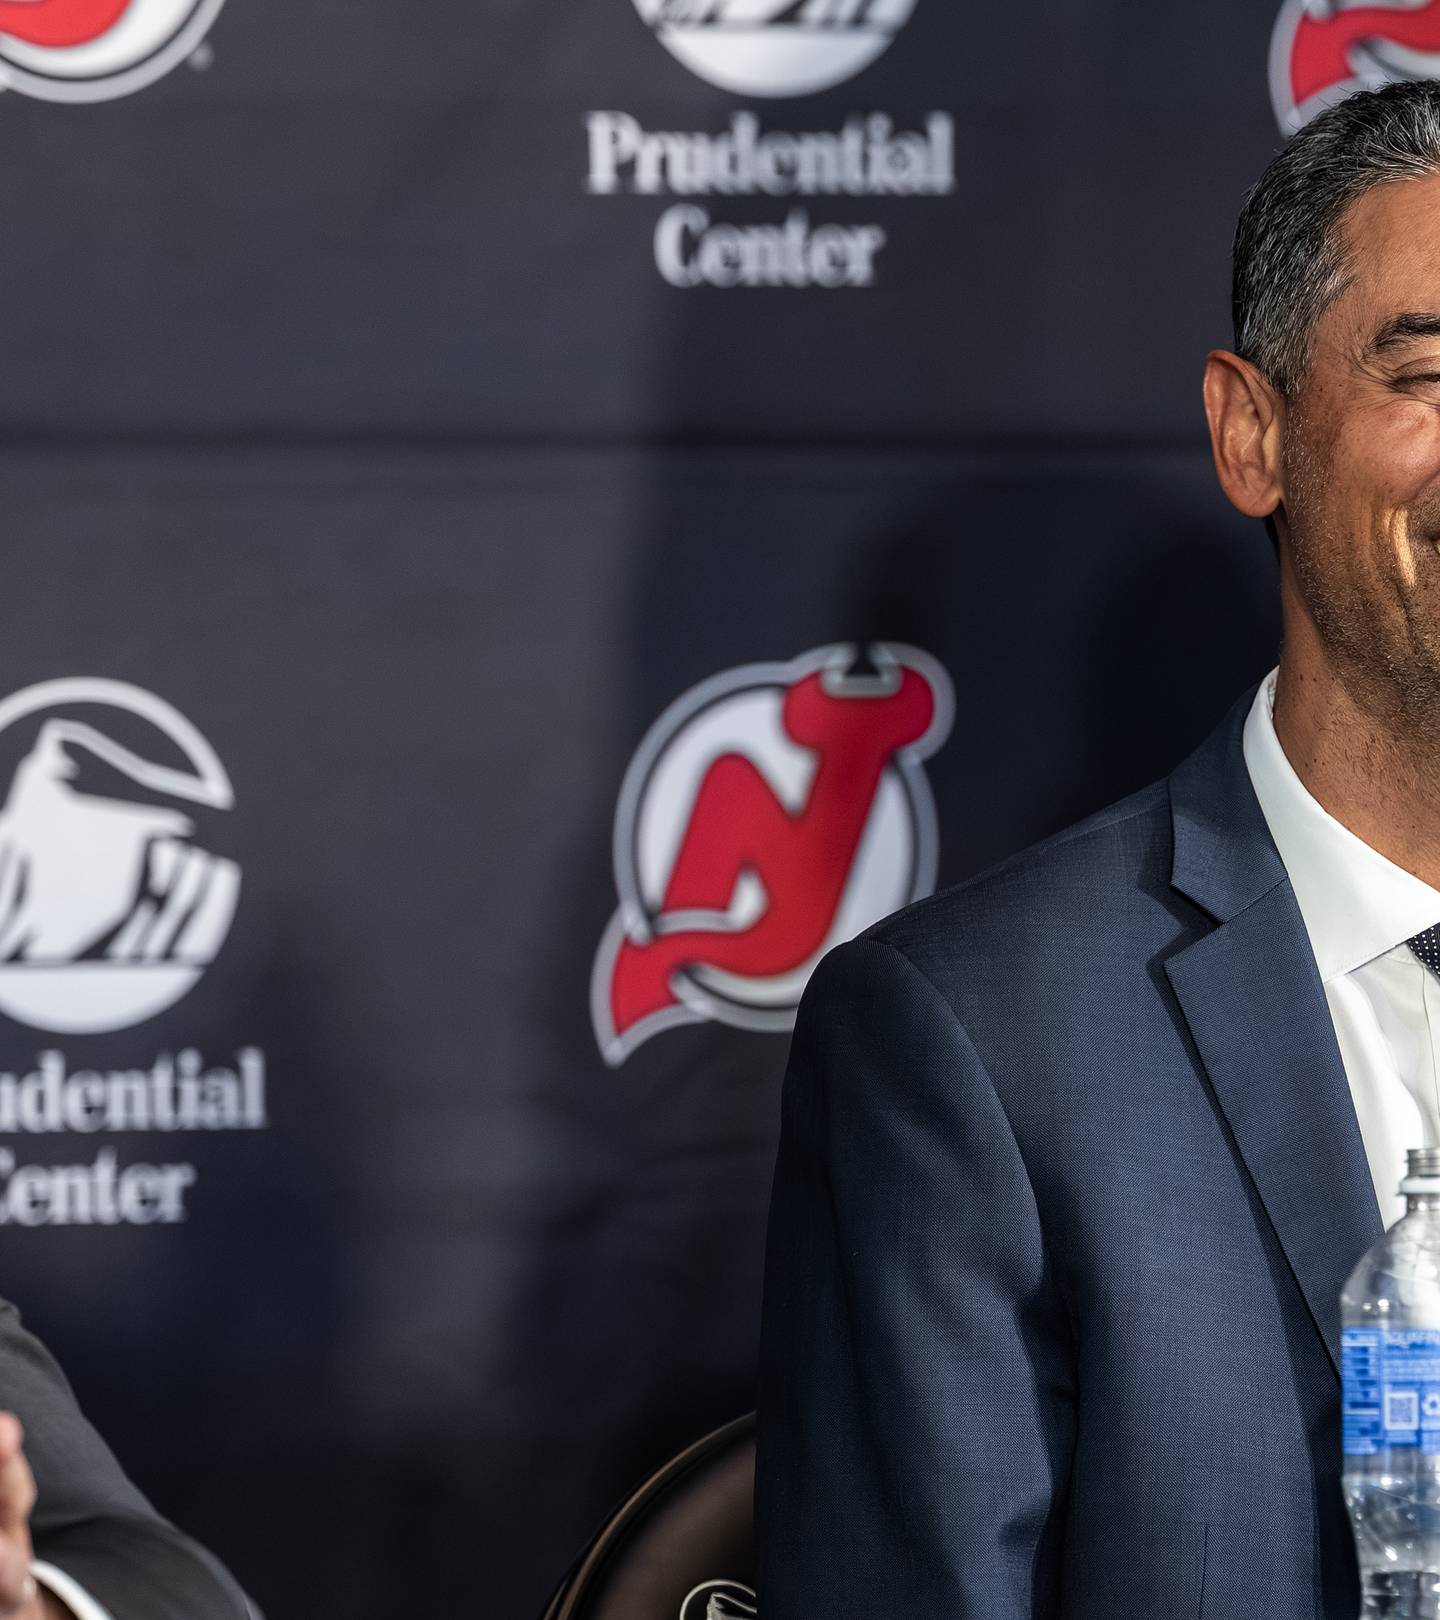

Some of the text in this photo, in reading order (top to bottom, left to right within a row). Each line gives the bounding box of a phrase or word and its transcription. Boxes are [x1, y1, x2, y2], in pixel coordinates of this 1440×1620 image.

[587, 110, 955, 195] Prudential
[653, 203, 887, 288] Center
[0, 1146, 196, 1227] enter
